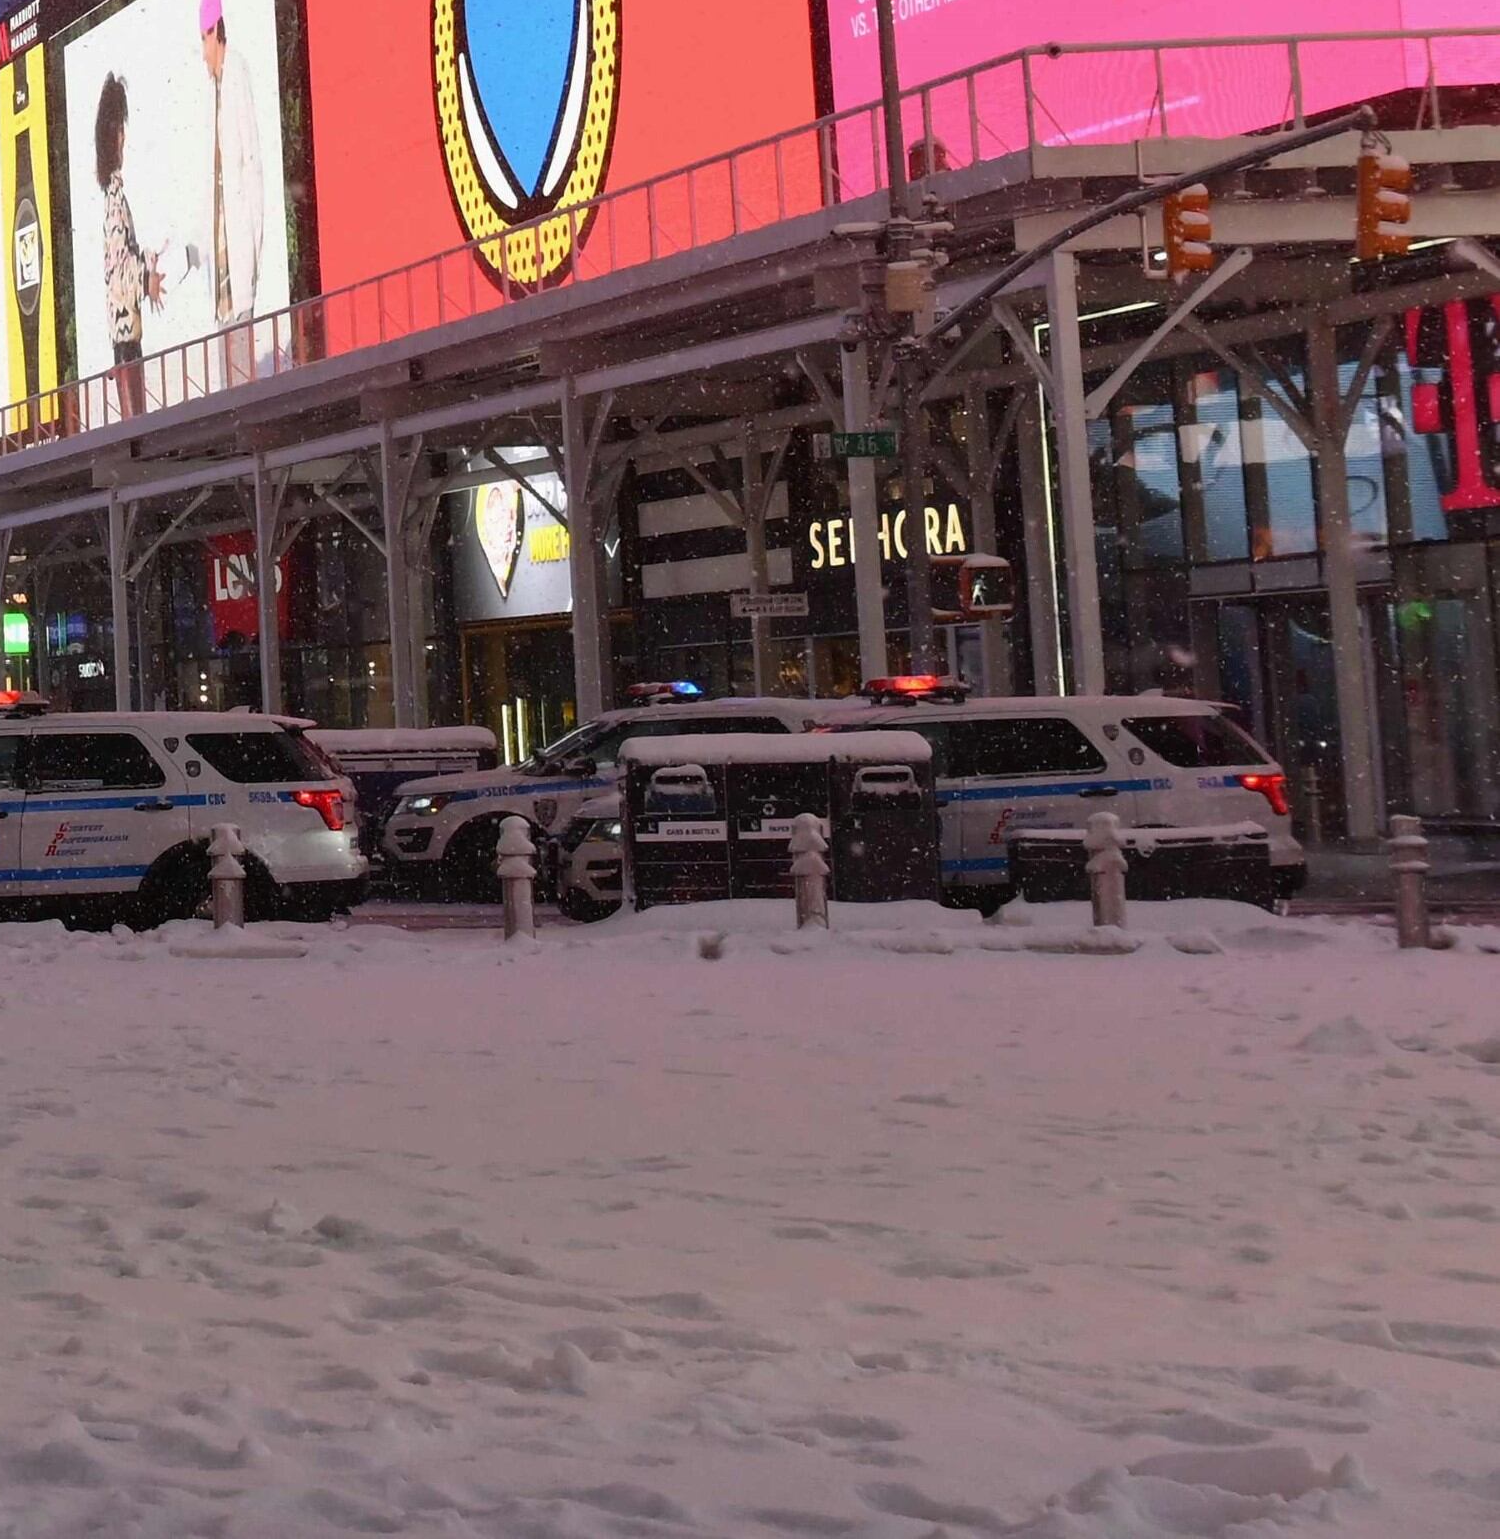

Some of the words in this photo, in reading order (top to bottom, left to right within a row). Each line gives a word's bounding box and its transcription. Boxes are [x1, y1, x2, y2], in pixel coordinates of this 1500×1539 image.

[10, 18, 38, 52] MARQUIS
[851, 12, 870, 38] VS.
[809, 503, 966, 569] SEHORA
